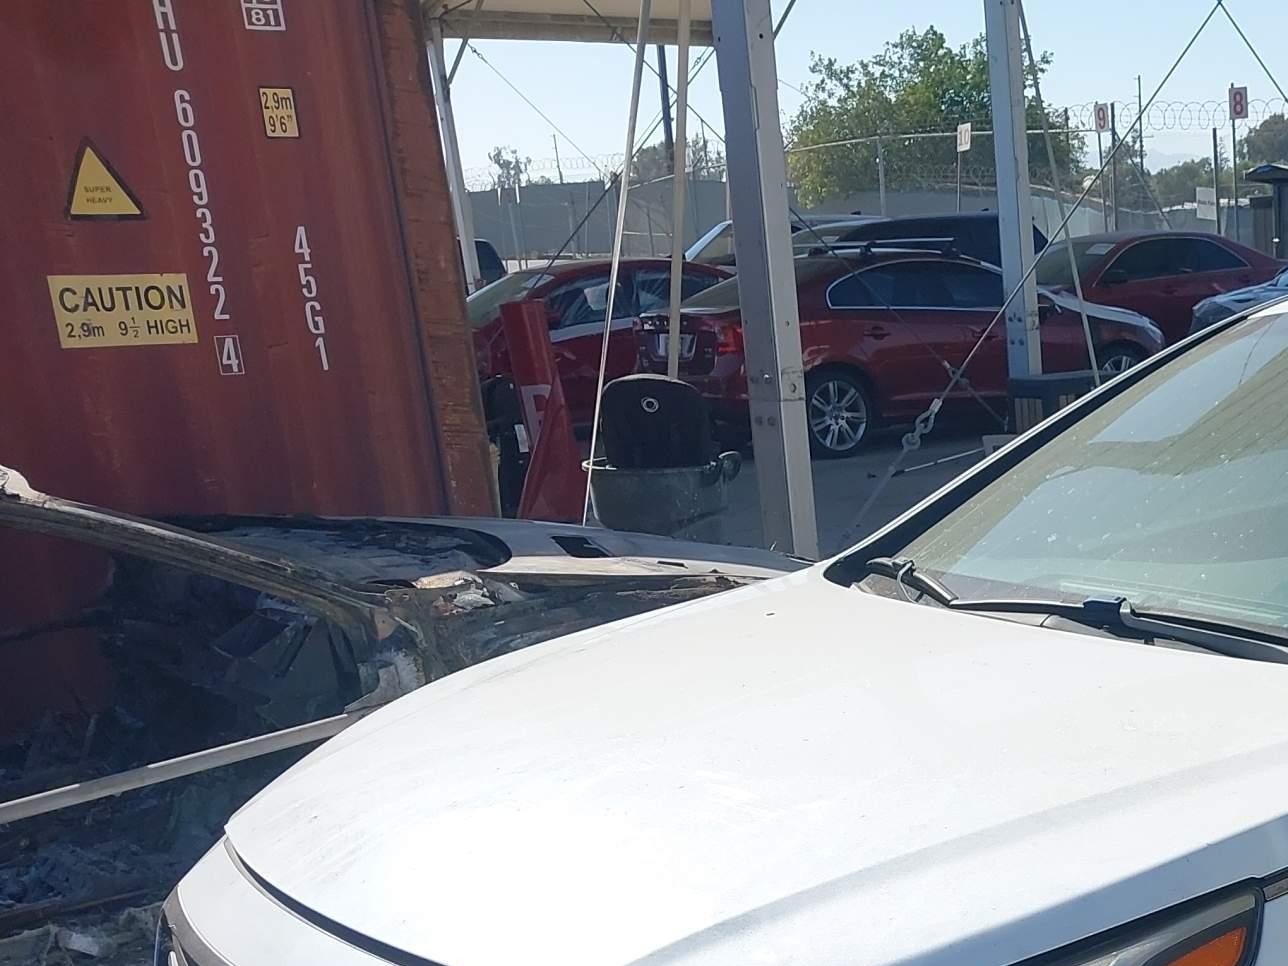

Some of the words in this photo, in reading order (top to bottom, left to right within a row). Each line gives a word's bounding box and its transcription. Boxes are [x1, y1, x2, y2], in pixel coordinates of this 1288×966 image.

[251, 9, 275, 26] 81
[1233, 91, 1243, 115] 8
[1097, 107, 1106, 130] 9
[959, 127, 970, 146] 10
[83, 185, 112, 193] SUPER
[58, 285, 187, 313] CAUTION
[294, 225, 329, 371] 45G1
[146, 319, 191, 335] HIGH
[222, 337, 239, 373] 4
